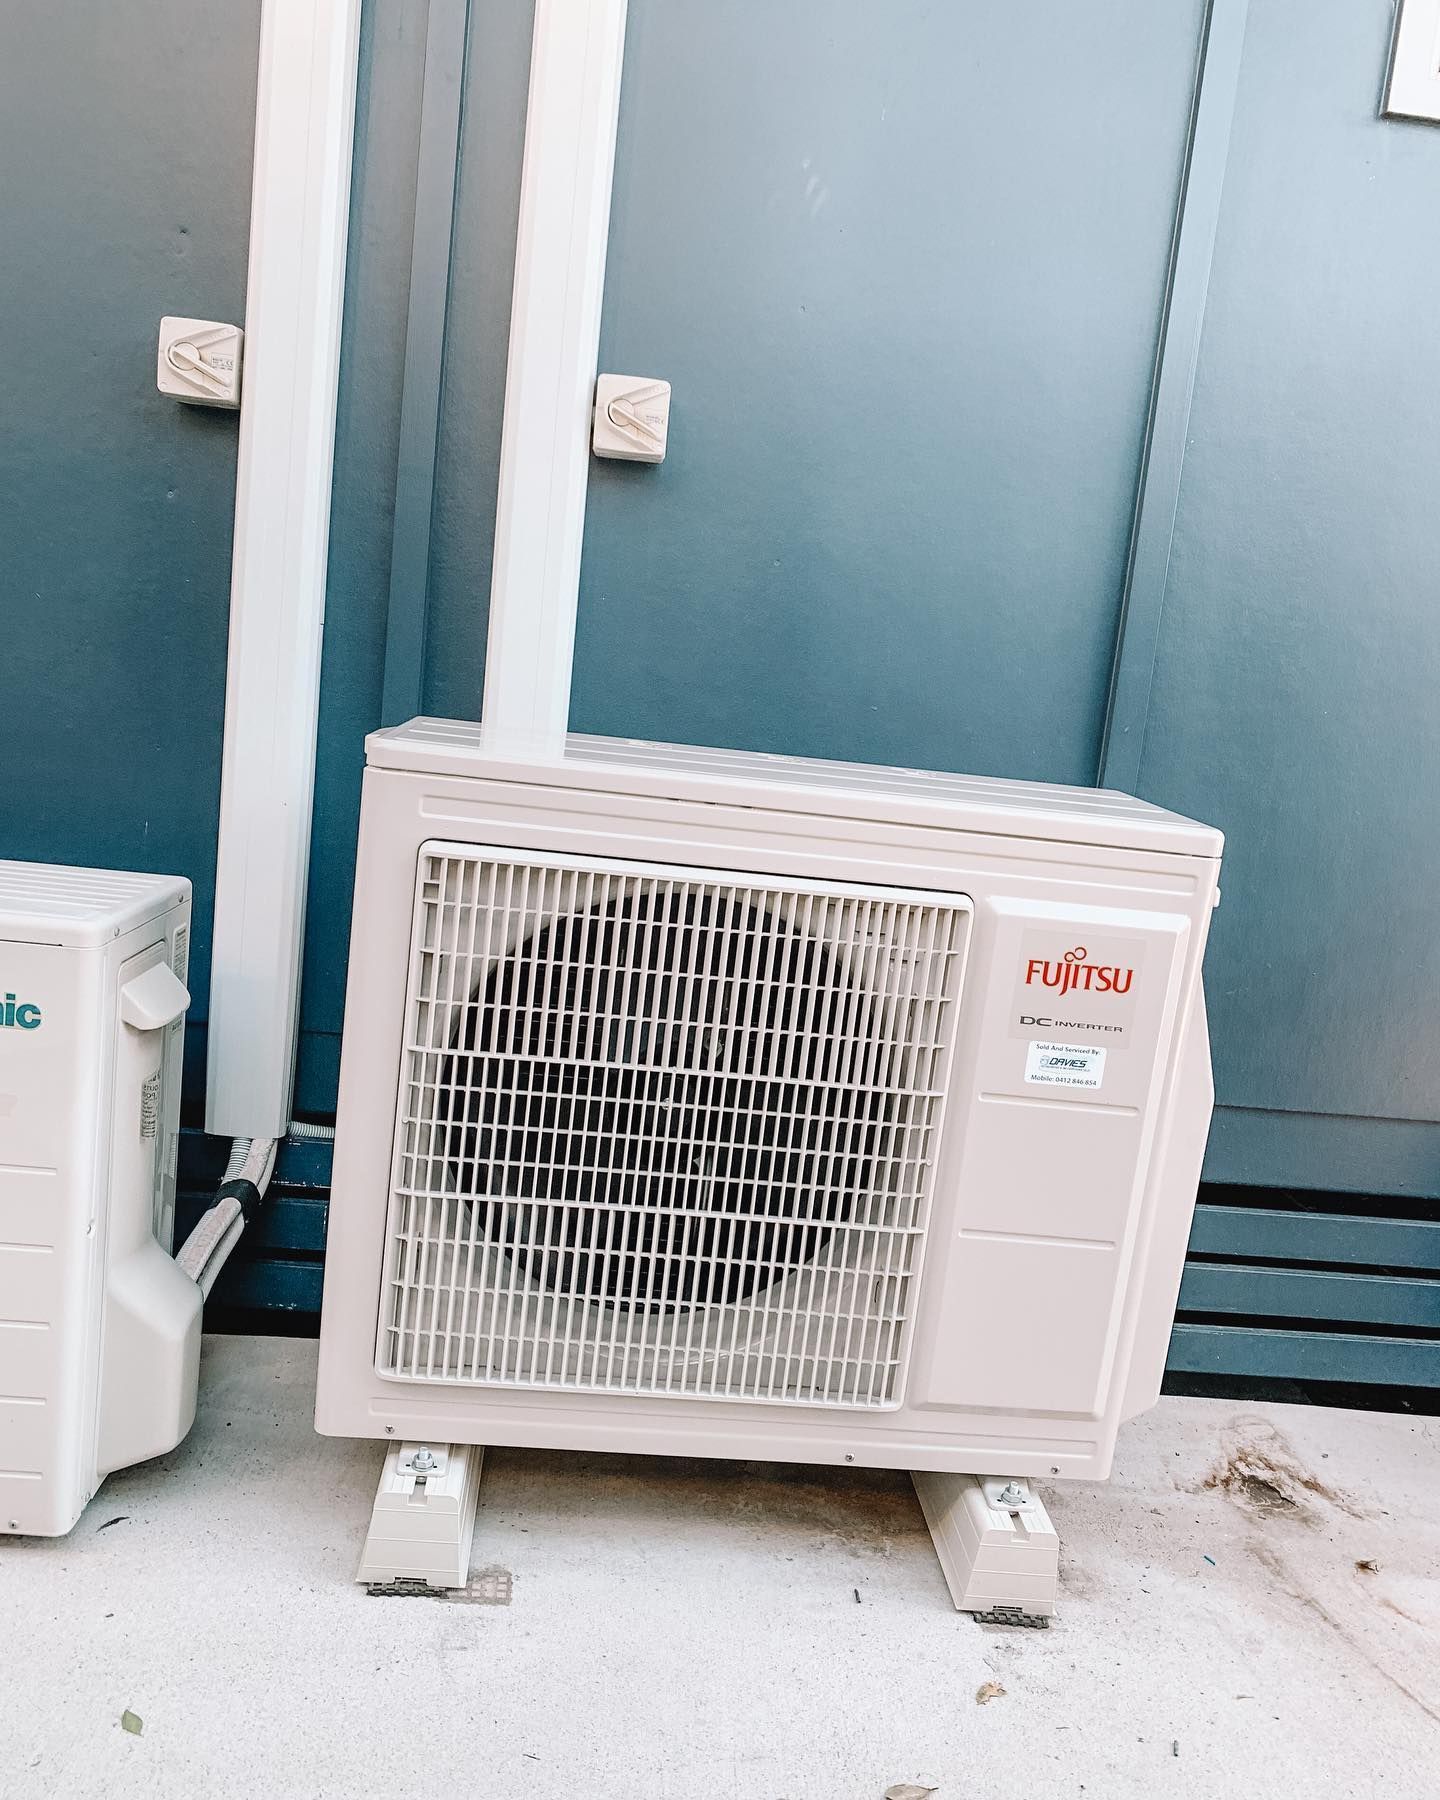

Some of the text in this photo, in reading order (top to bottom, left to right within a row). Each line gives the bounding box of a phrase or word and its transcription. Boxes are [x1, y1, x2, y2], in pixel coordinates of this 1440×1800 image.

[1025, 947, 1134, 996] FUJITSU
[0, 993, 42, 1029] ic
[1019, 1015, 1124, 1033] DC INVERTER
[1065, 1046, 1091, 1055] Serviced
[1049, 1057, 1088, 1068] DAVIES
[1030, 1074, 1055, 1082] Mobile:
[1055, 1076, 1071, 1084] 0412
